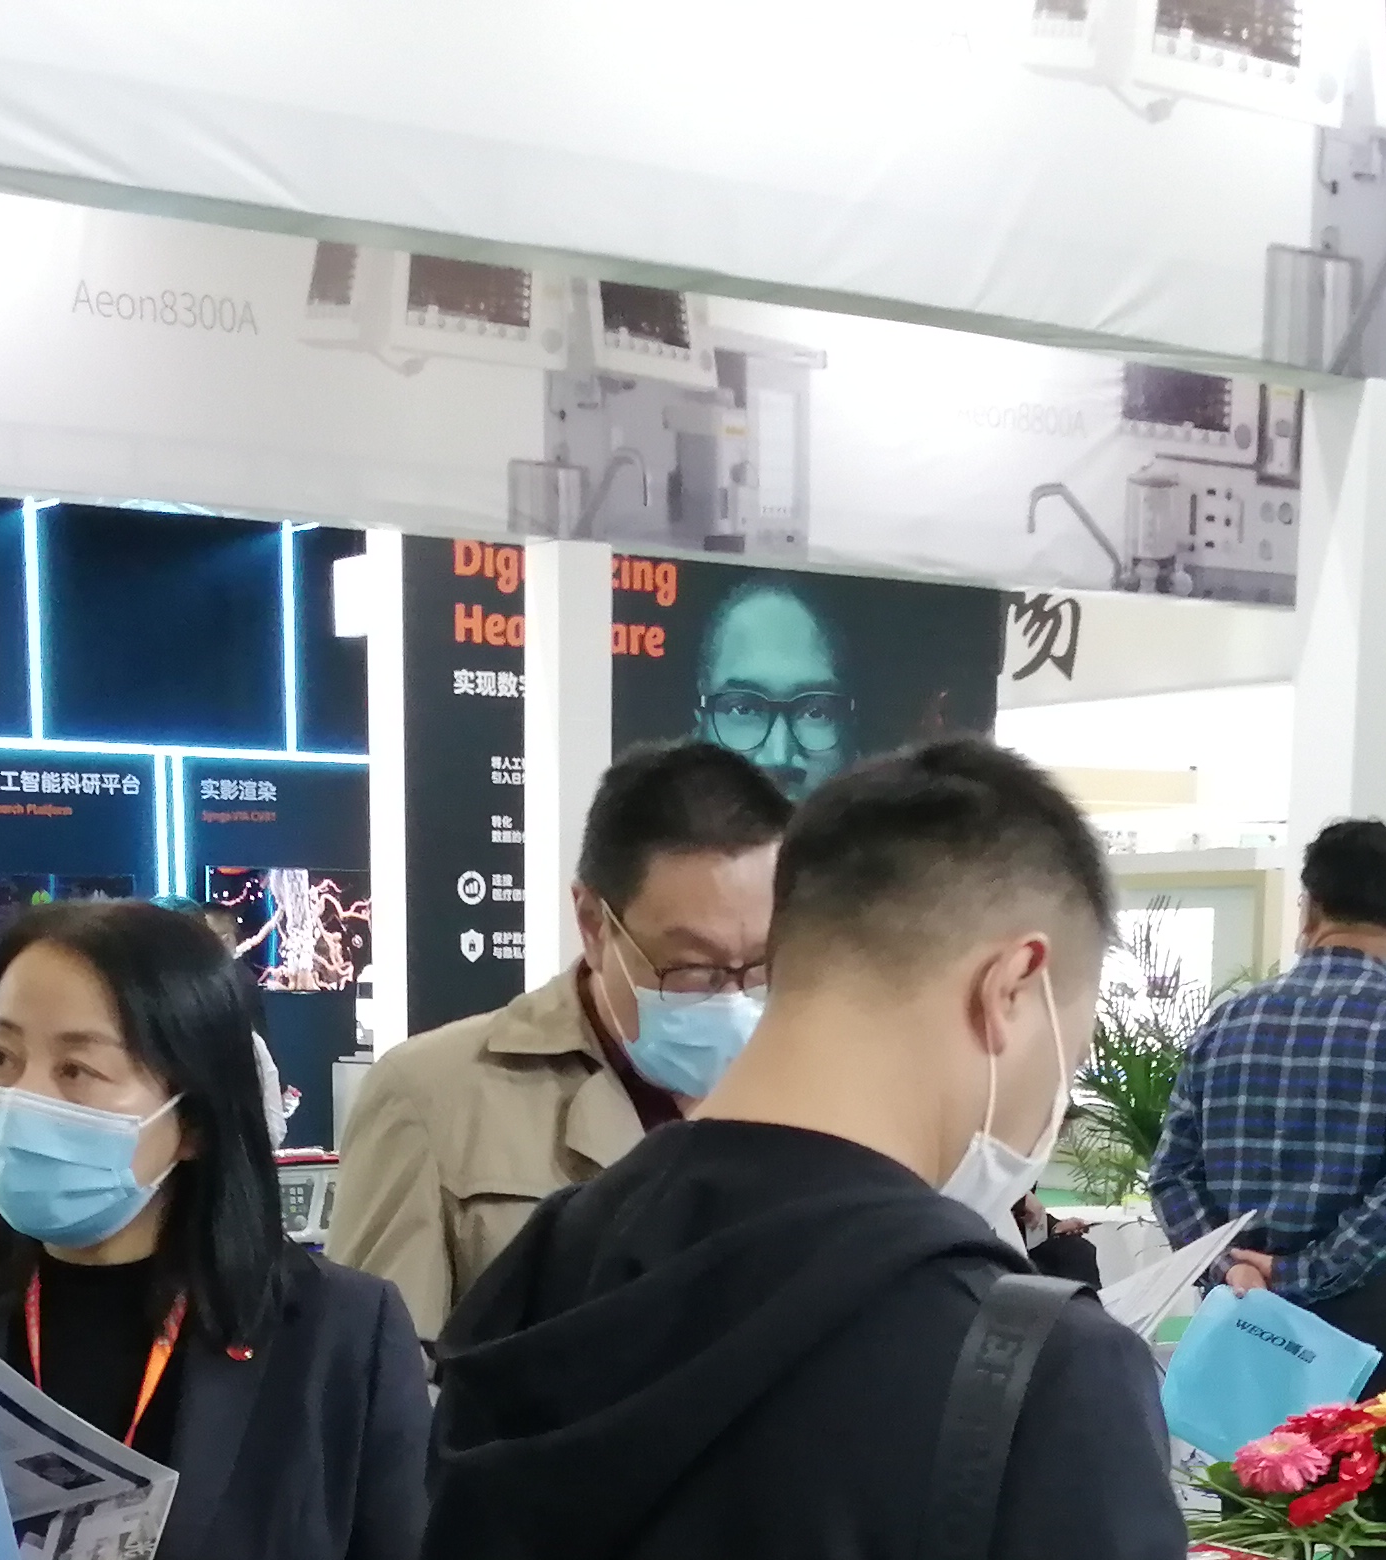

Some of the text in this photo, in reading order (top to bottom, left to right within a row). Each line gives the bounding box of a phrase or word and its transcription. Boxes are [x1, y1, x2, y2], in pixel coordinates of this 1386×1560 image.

[71, 278, 260, 335] Aeon8300A
[453, 669, 525, 698] 实现数
[200, 777, 278, 802] 实影渲染
